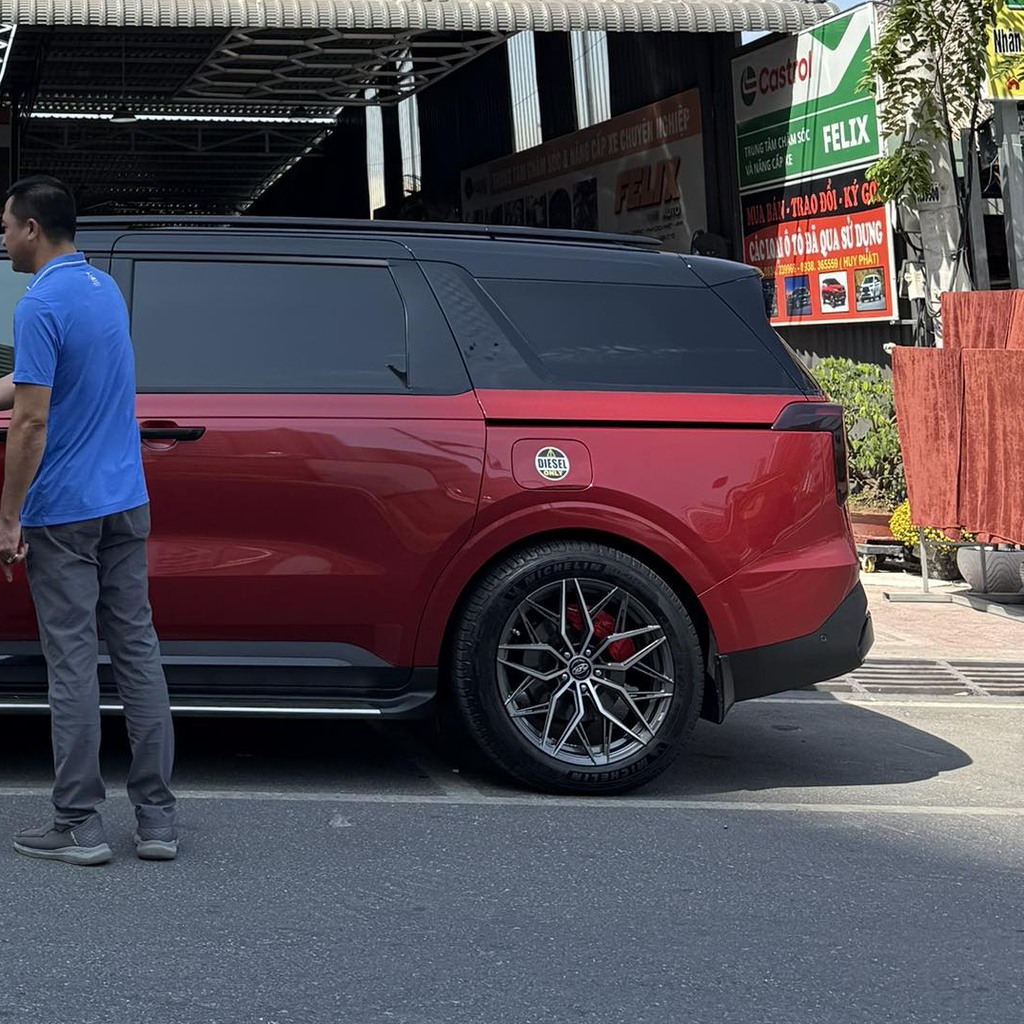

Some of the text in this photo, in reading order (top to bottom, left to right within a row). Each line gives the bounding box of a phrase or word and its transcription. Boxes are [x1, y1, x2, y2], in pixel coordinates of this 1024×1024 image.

[759, 50, 813, 94] Castrol
[796, 127, 811, 144] SÓC
[822, 114, 870, 154] FELIX
[614, 157, 681, 215] FELIX
[746, 204, 765, 226] MUA
[766, 196, 785, 222] BÁN
[790, 192, 818, 218] TRAO
[819, 178, 838, 215] ĐỔI
[749, 234, 765, 262] CÁC
[784, 229, 791, 256] Ô
[792, 228, 804, 256] TÔ
[805, 224, 819, 254] ĐÃ
[819, 226, 842, 257] QUA
[841, 215, 854, 249] SỬ
[855, 219, 883, 254] DỤNG
[843, 257, 857, 268] HUY
[537, 458, 567, 469] DIESEL
